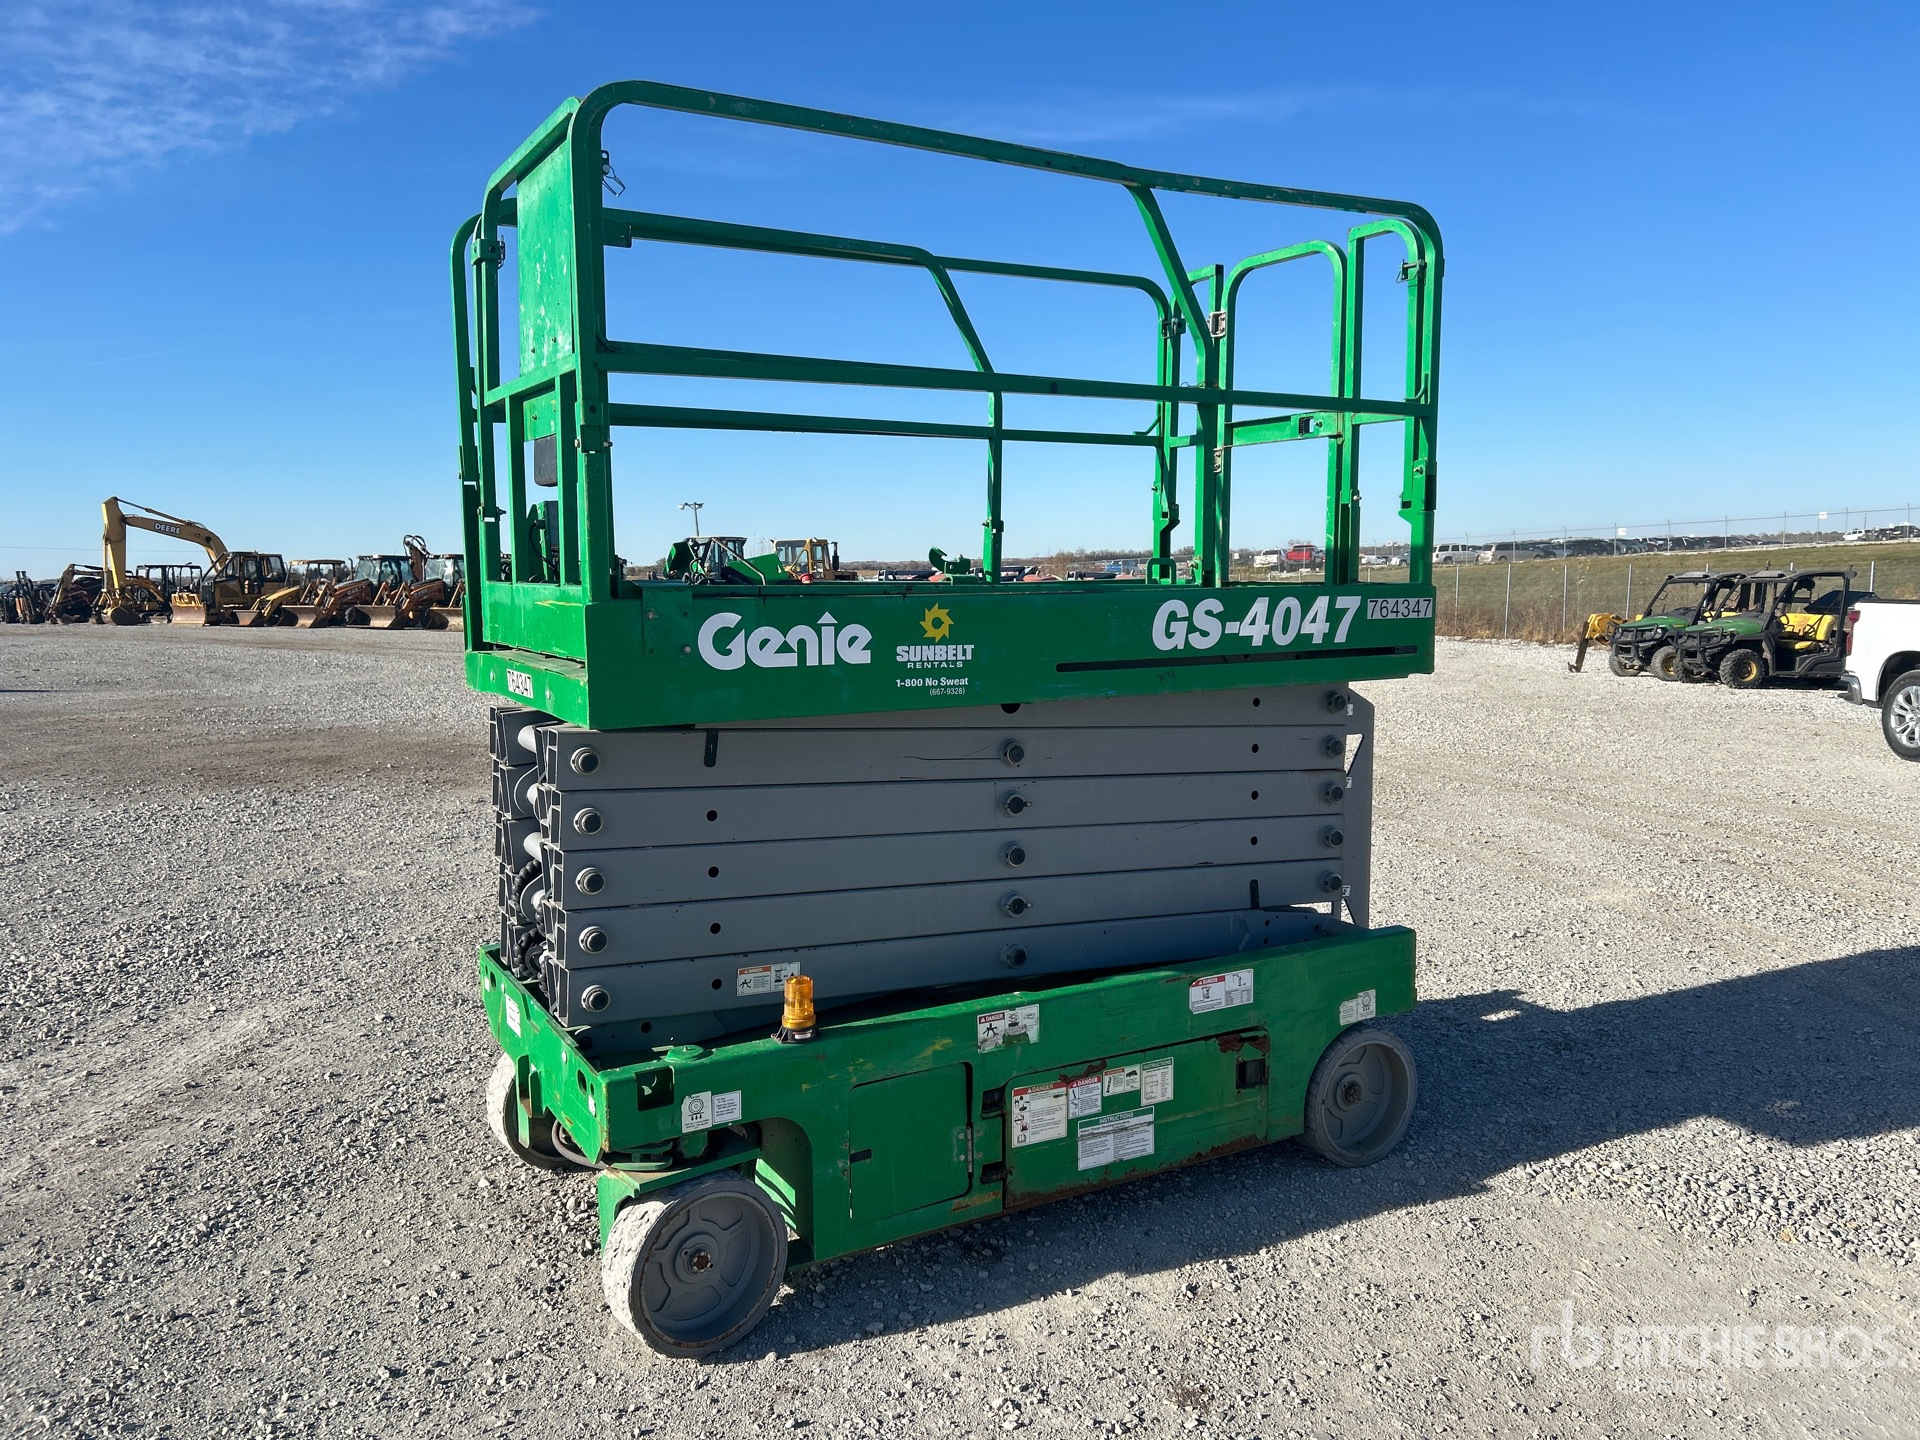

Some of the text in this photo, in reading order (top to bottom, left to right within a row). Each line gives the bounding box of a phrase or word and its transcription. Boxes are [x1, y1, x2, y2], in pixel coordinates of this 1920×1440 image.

[154, 522, 181, 534] DEERE
[1369, 598, 1432, 619] 764347
[1151, 595, 1362, 651] GS-4047
[697, 611, 873, 671] Genie
[896, 644, 975, 662] SUNBELT
[907, 661, 963, 669] RENTALS
[507, 670, 532, 697] 764347
[896, 677, 969, 688] 1-800 No Sweat
[929, 687, 966, 697] (667-9328)
[985, 1013, 1004, 1022] DANGER
[1032, 1083, 1054, 1093] DANGER
[1077, 1077, 1098, 1087] DANGER
[1098, 1112, 1134, 1124] INSTRUCTIONS
